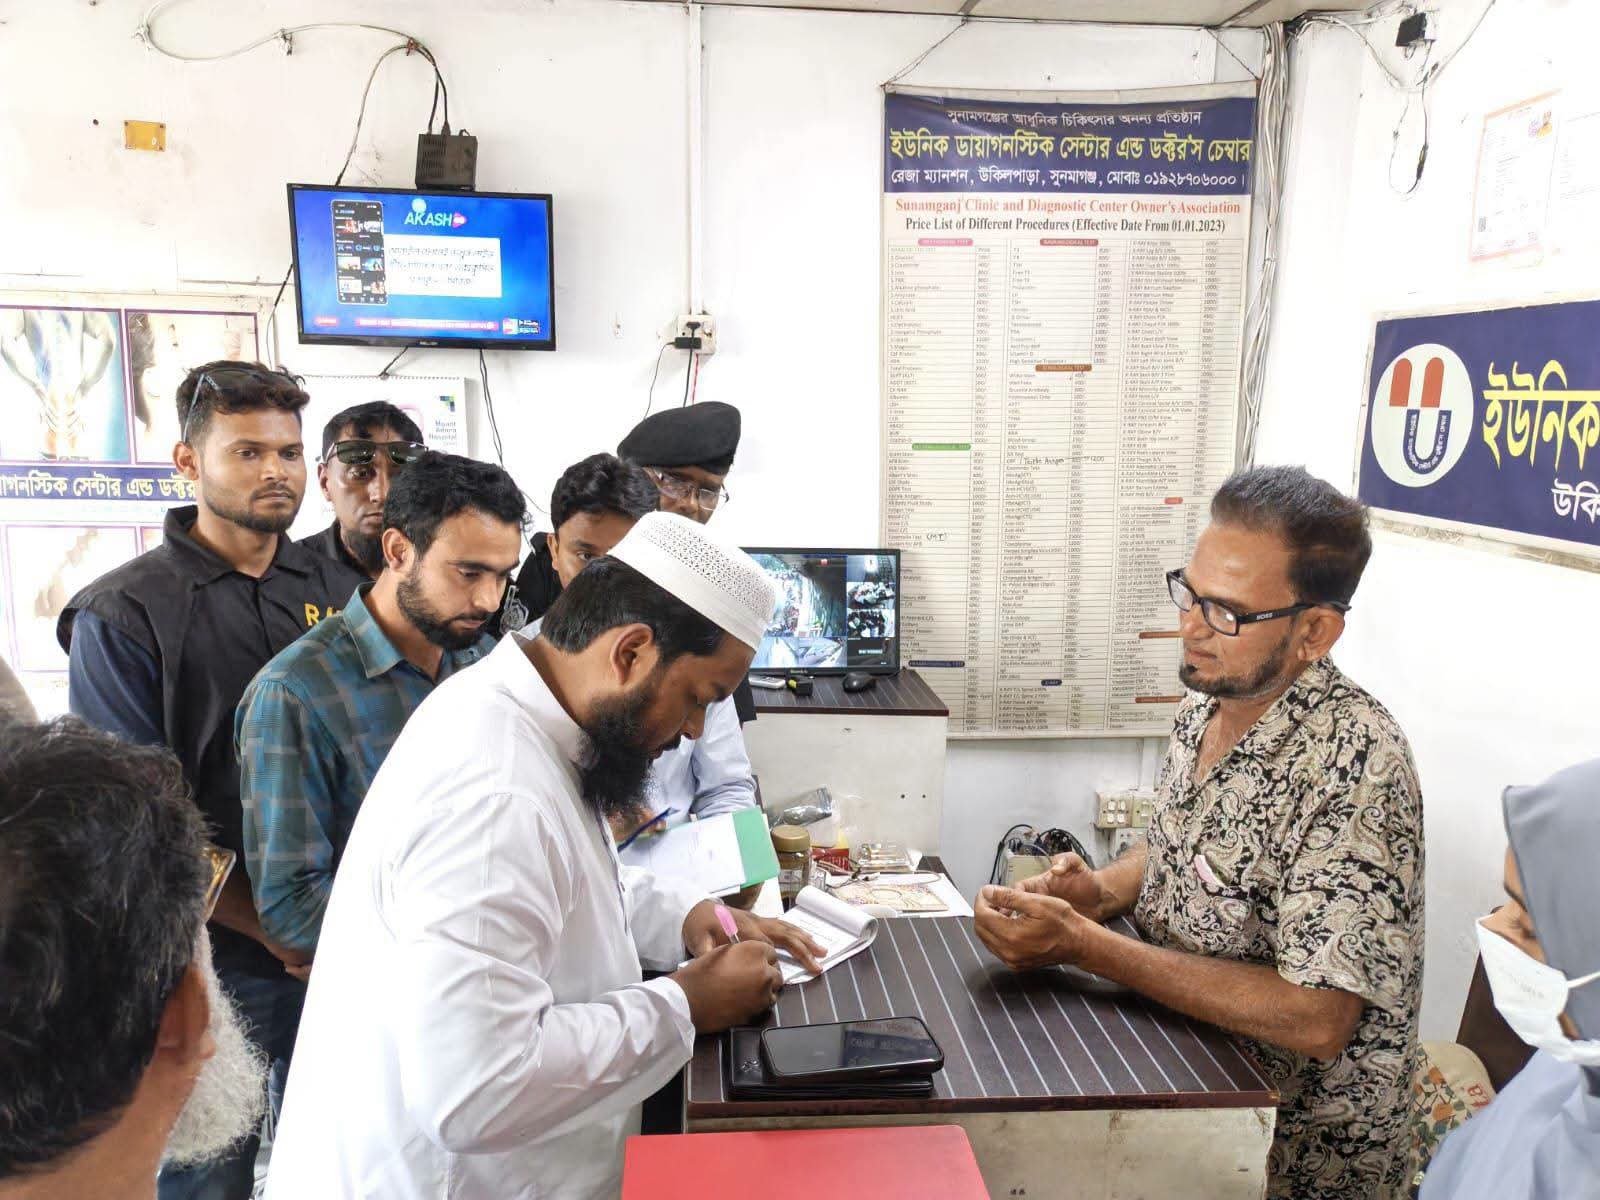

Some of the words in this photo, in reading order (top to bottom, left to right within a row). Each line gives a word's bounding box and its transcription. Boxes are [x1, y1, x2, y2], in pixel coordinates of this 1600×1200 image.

[1012, 112, 1058, 128] আধুনিক
[1061, 112, 1114, 127] চিকিৎসার
[1119, 114, 1152, 125] অনন্য
[1156, 109, 1202, 125] প্রতিষ্ঠান
[890, 127, 949, 159] ইউনিক
[954, 129, 1054, 159] ডায়াগনস্টিক
[1060, 132, 1112, 160] সেন্টার
[1116, 136, 1145, 160] এন্ড
[1207, 139, 1252, 162] চেম্বার
[891, 168, 919, 184] রেজা
[965, 198, 999, 212] Clinic
[1003, 199, 1024, 212] and
[1028, 199, 1086, 215] Diagnostic
[1089, 200, 1126, 213] Center
[1131, 199, 1175, 214] Owner's
[1180, 200, 1240, 214] Association
[404, 211, 452, 227] AKASH
[906, 217, 930, 230] Price
[934, 217, 952, 230] List
[956, 217, 966, 230] of
[969, 217, 1012, 231] Different
[1016, 218, 1069, 231] Procedures
[1072, 218, 1118, 232] (Effective
[1121, 219, 1142, 232] Date
[1145, 219, 1169, 232] From
[1172, 219, 1225, 233] 01.01.2023)
[1482, 359, 1600, 471] ইউনিক
[73, 470, 122, 497] সেন্টার
[127, 478, 154, 497] এন্ড
